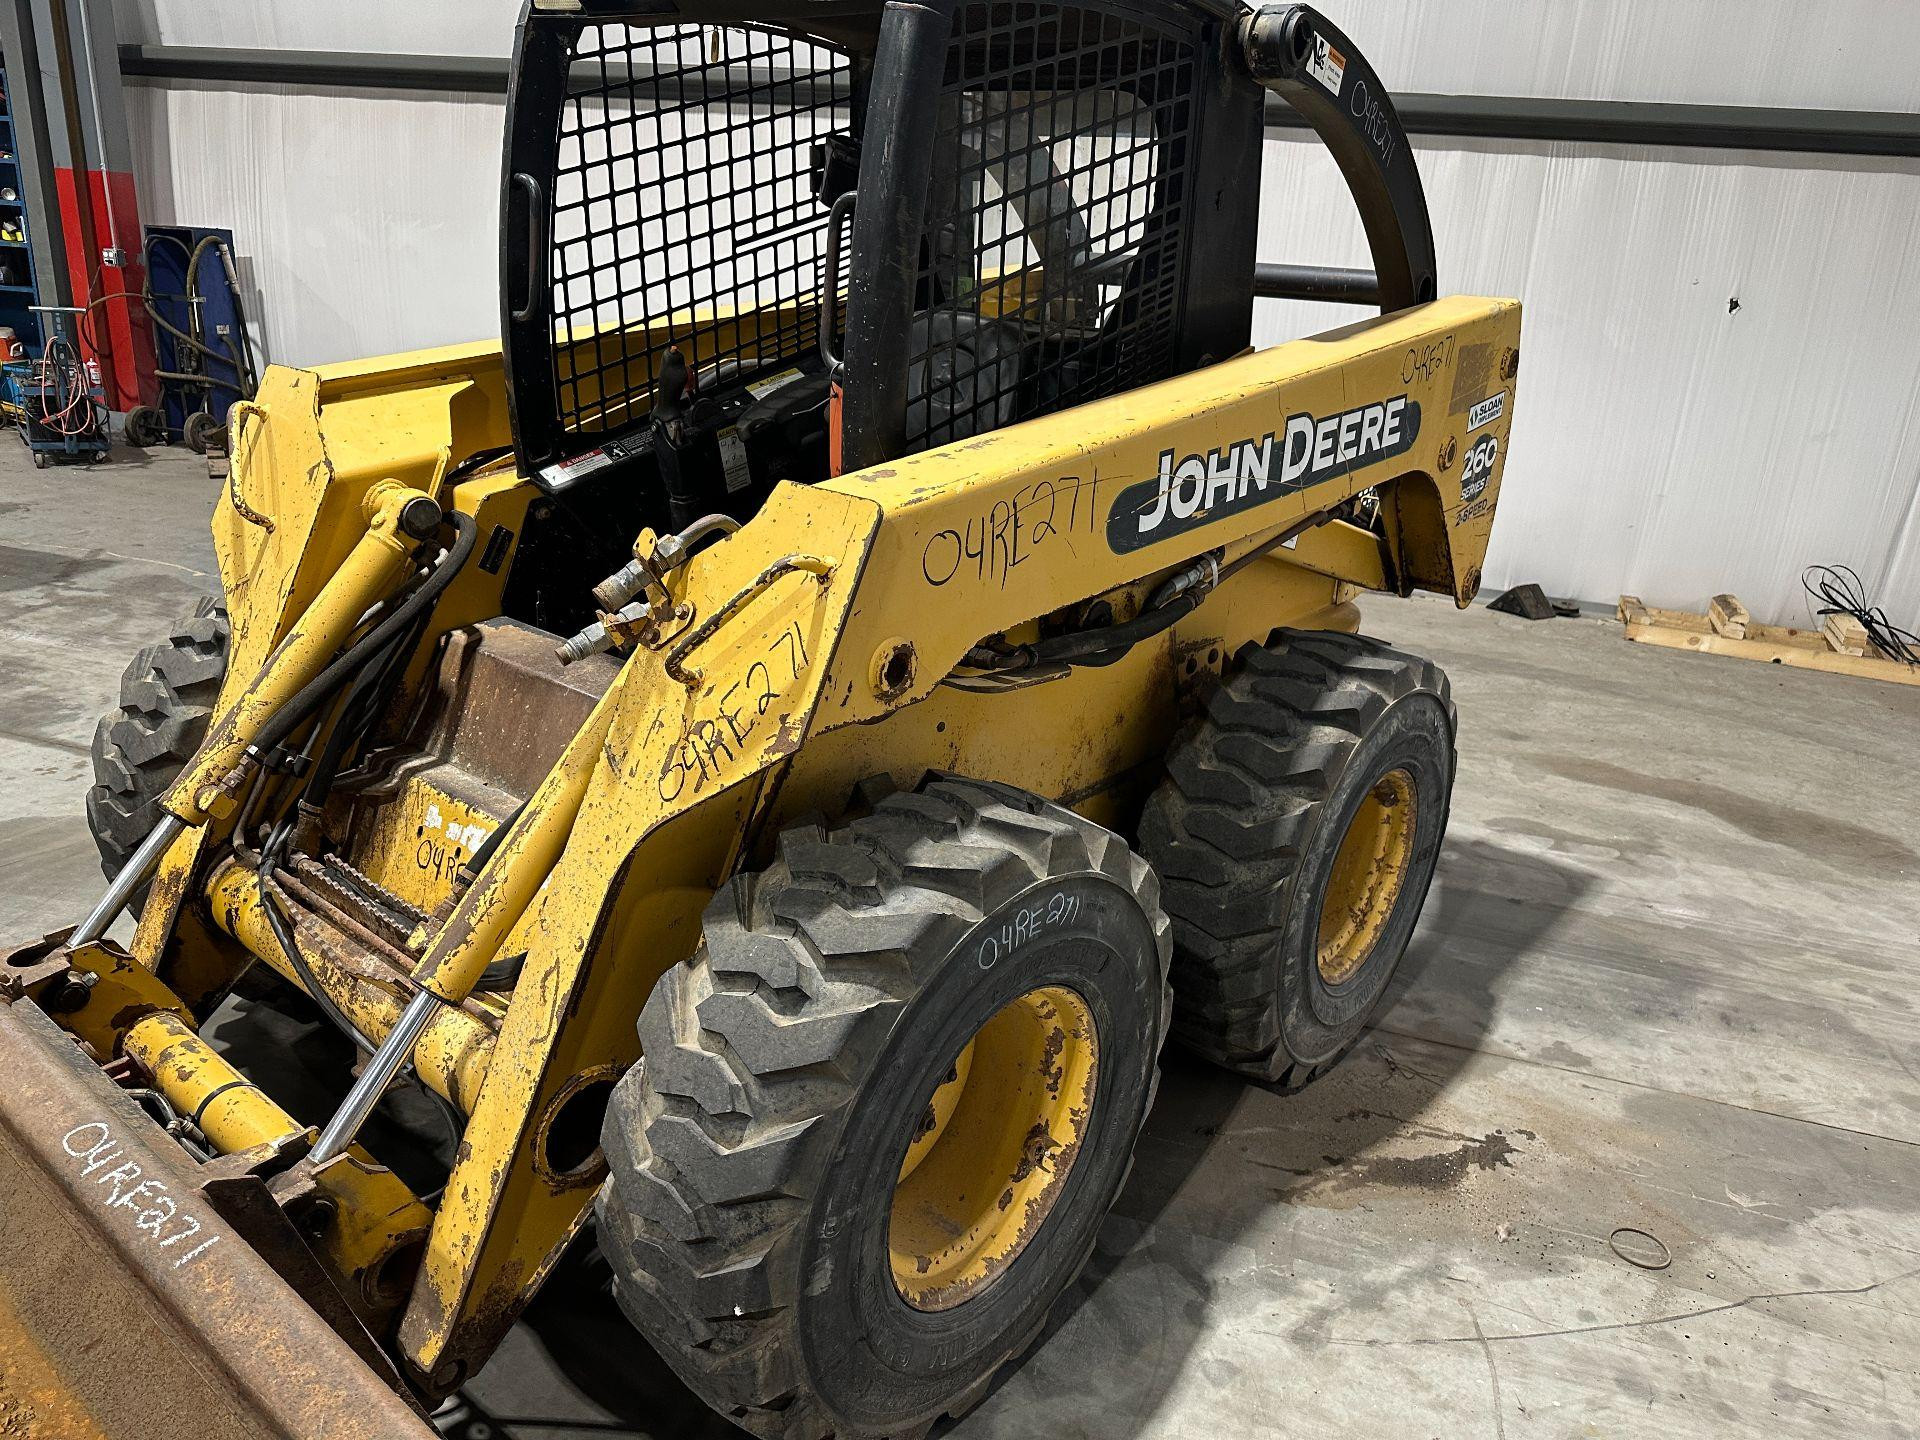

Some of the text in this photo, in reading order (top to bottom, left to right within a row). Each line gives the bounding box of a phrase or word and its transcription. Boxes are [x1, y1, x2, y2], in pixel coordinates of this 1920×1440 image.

[1479, 395, 1504, 416] SLOAN
[1138, 397, 1407, 533] JOHN DEERE
[1460, 476, 1486, 500] SERIES
[1461, 437, 1498, 482] 260
[922, 466, 1099, 590] 04RE271
[659, 621, 810, 802] 04RE271
[978, 891, 1080, 970] 04RE271
[62, 1121, 221, 1270] 04RE271
